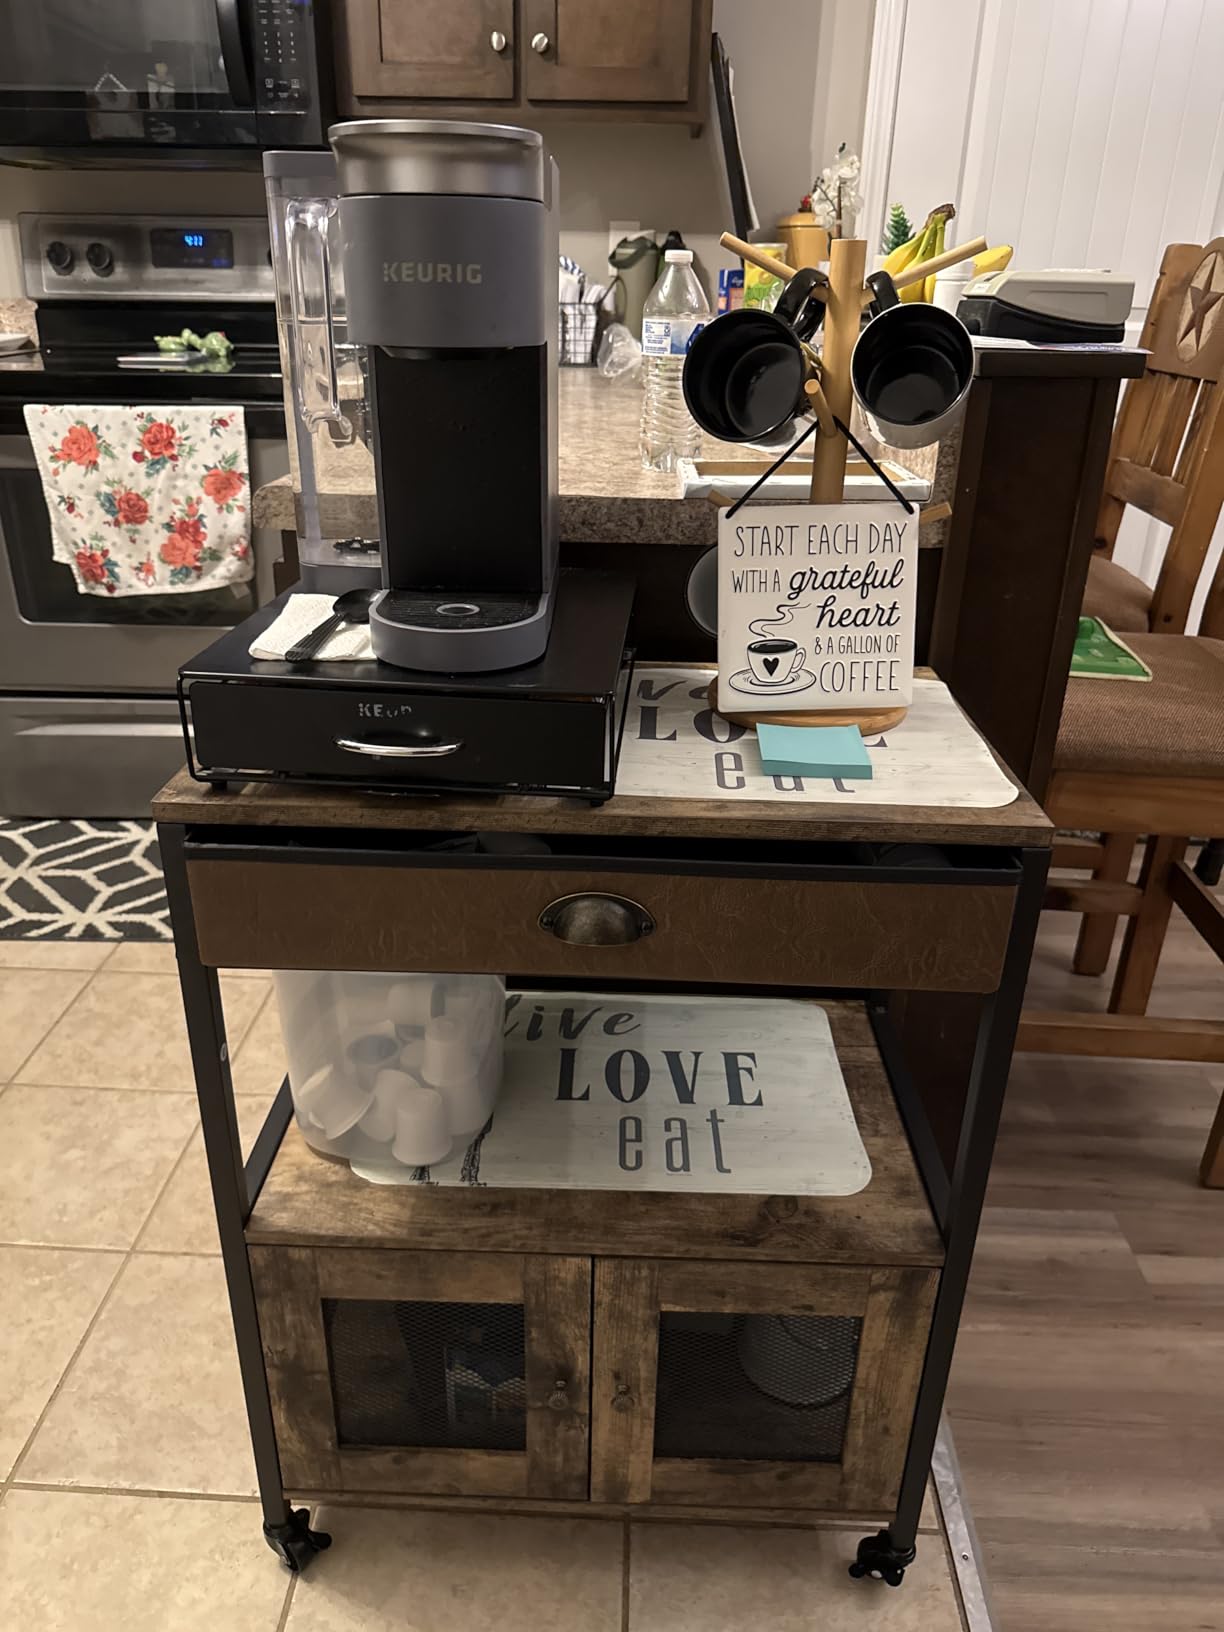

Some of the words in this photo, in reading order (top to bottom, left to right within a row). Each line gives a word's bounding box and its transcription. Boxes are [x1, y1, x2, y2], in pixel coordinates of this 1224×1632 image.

[383, 262, 482, 284] KEURIG
[734, 526, 800, 557] START
[808, 523, 858, 555] EACH
[869, 522, 908, 554] DAY
[732, 569, 768, 593] WITH
[772, 569, 781, 593] A
[787, 558, 905, 600] grateful
[816, 594, 901, 629] heart
[814, 636, 823, 655] &
[826, 636, 834, 655] A
[838, 635, 882, 654] GALLON
[885, 634, 901, 653] OF
[819, 660, 901, 693] COFFEE
[555, 1048, 764, 1106] LOVE
[619, 1108, 731, 1174] eat
